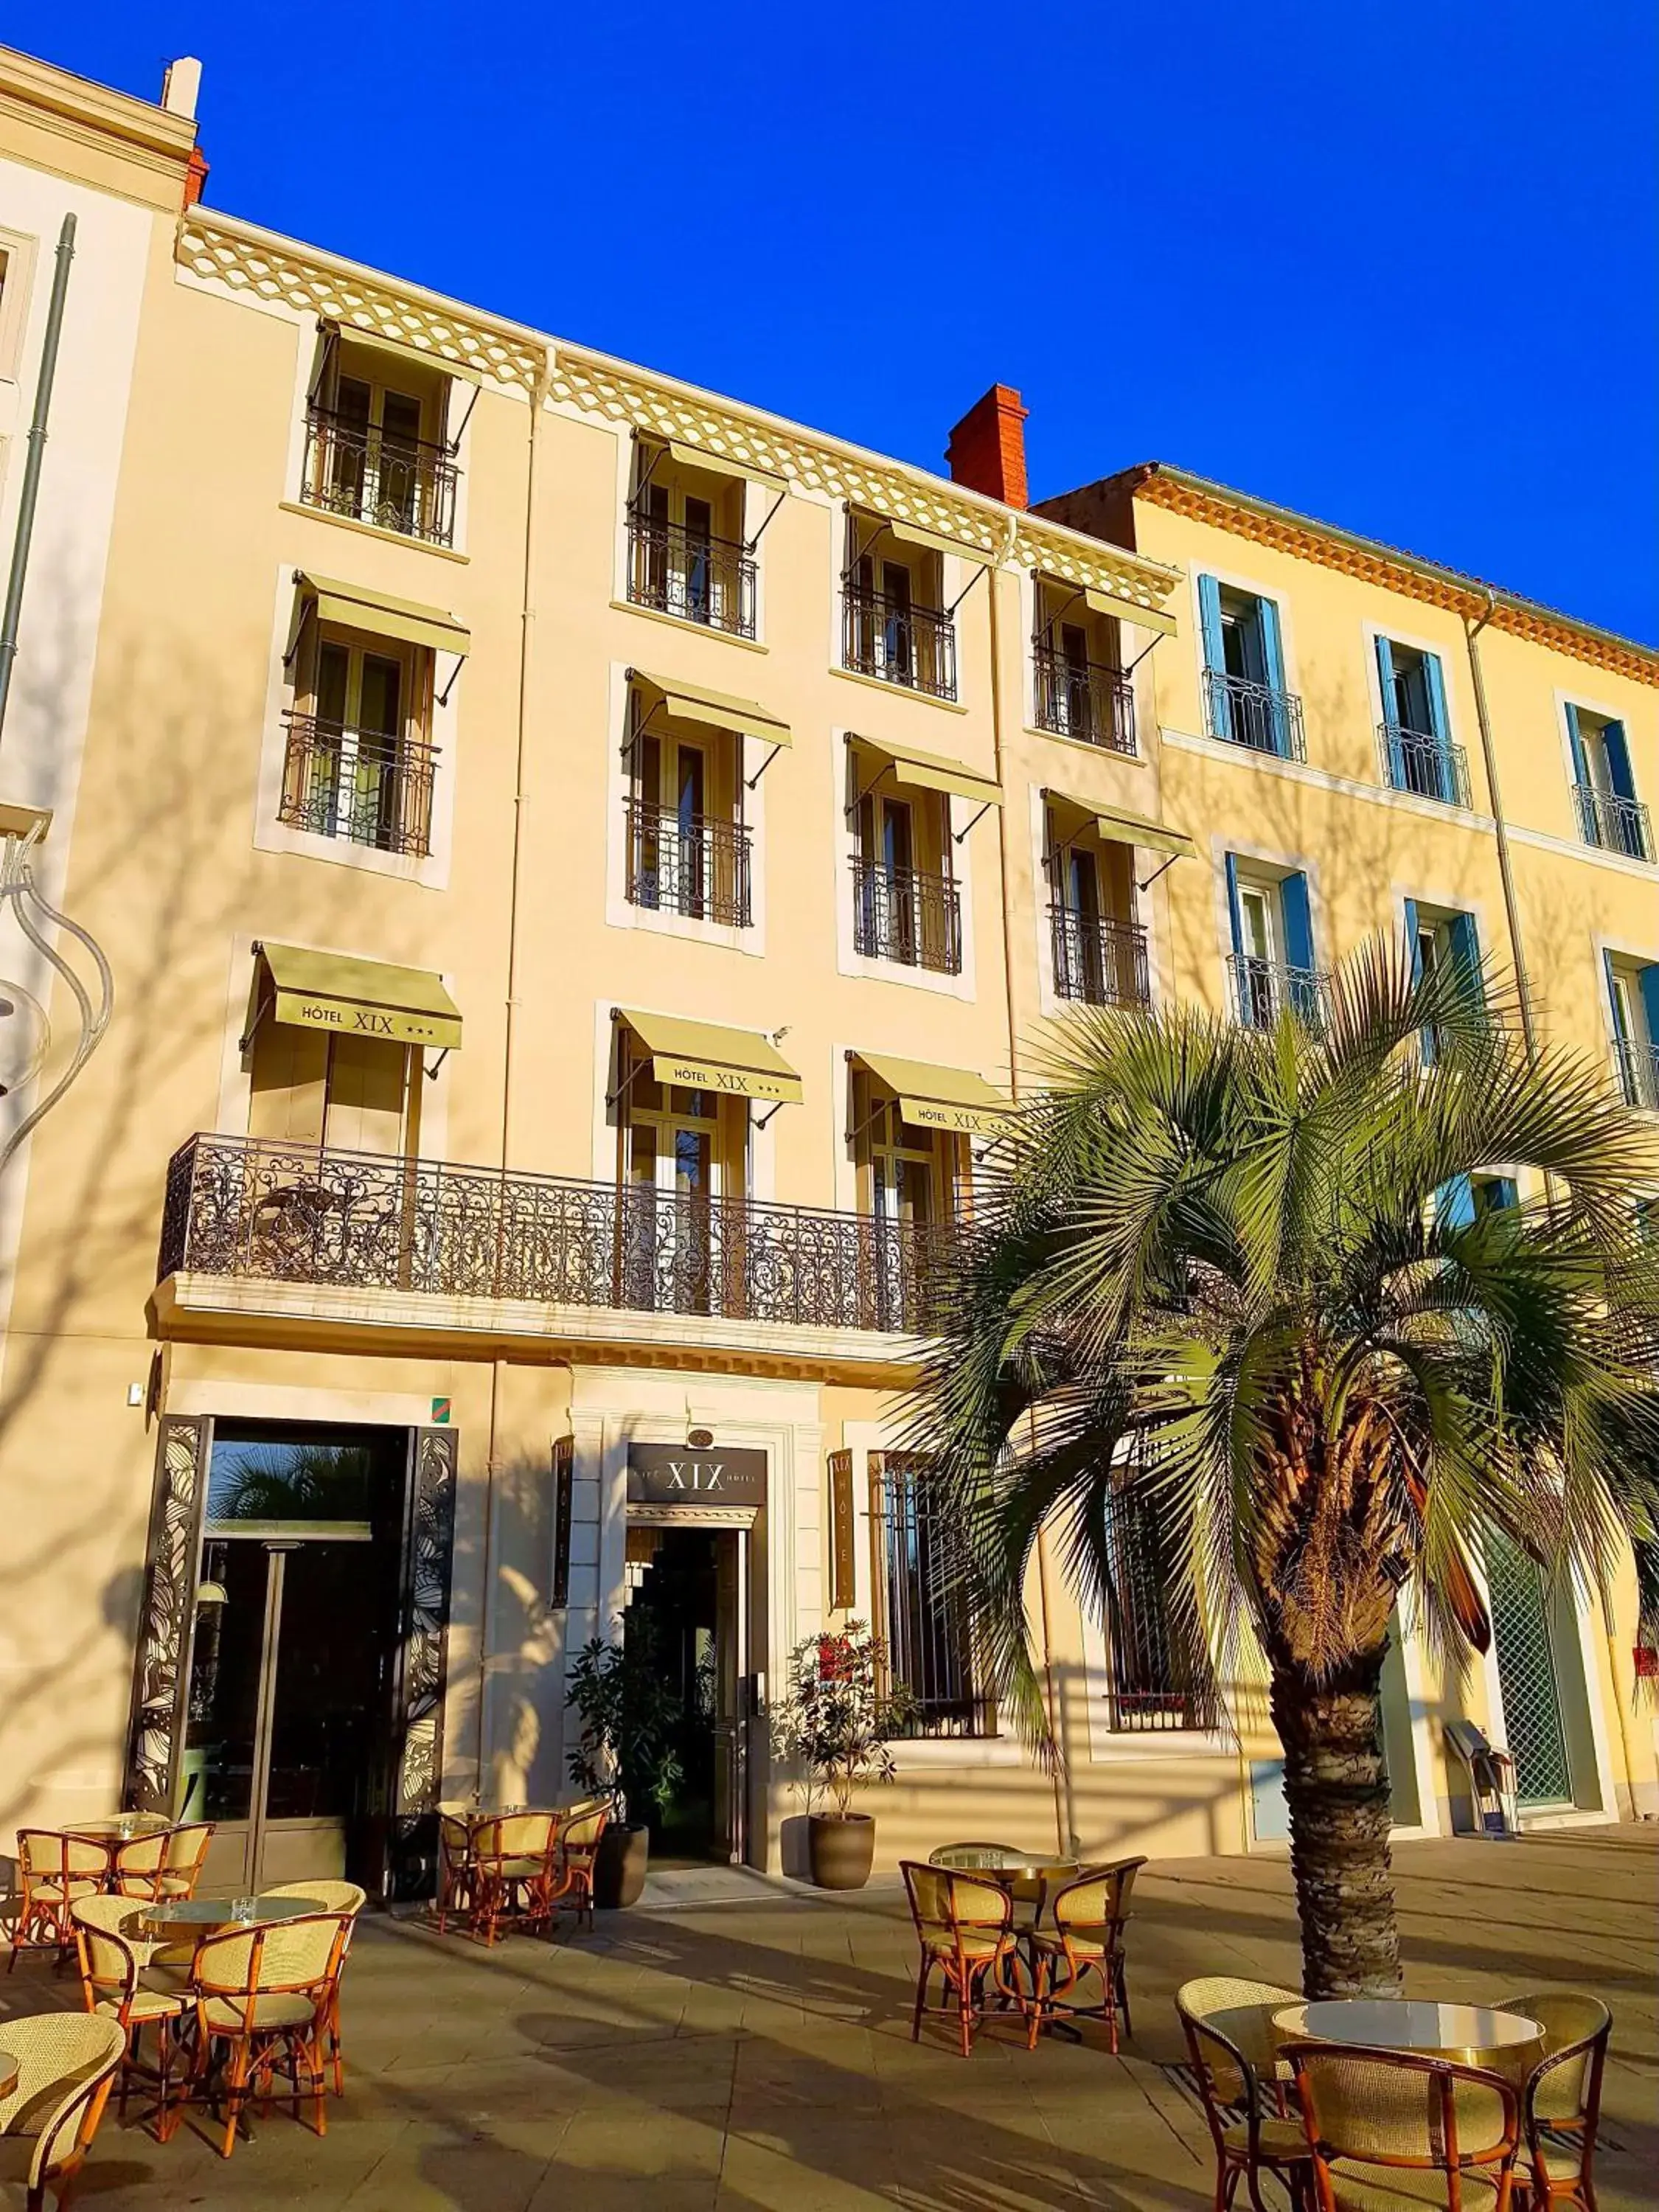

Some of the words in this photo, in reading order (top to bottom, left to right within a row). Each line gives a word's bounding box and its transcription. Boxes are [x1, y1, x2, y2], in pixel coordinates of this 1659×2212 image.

[301, 1006, 343, 1023] HÔTEL
[352, 1011, 394, 1034] XIX
[674, 1068, 709, 1083] HÔTEL
[716, 1073, 749, 1092] XIX
[918, 1109, 947, 1123] HÔTEL
[953, 1113, 981, 1130] XIX
[666, 1462, 726, 1491] XIX
